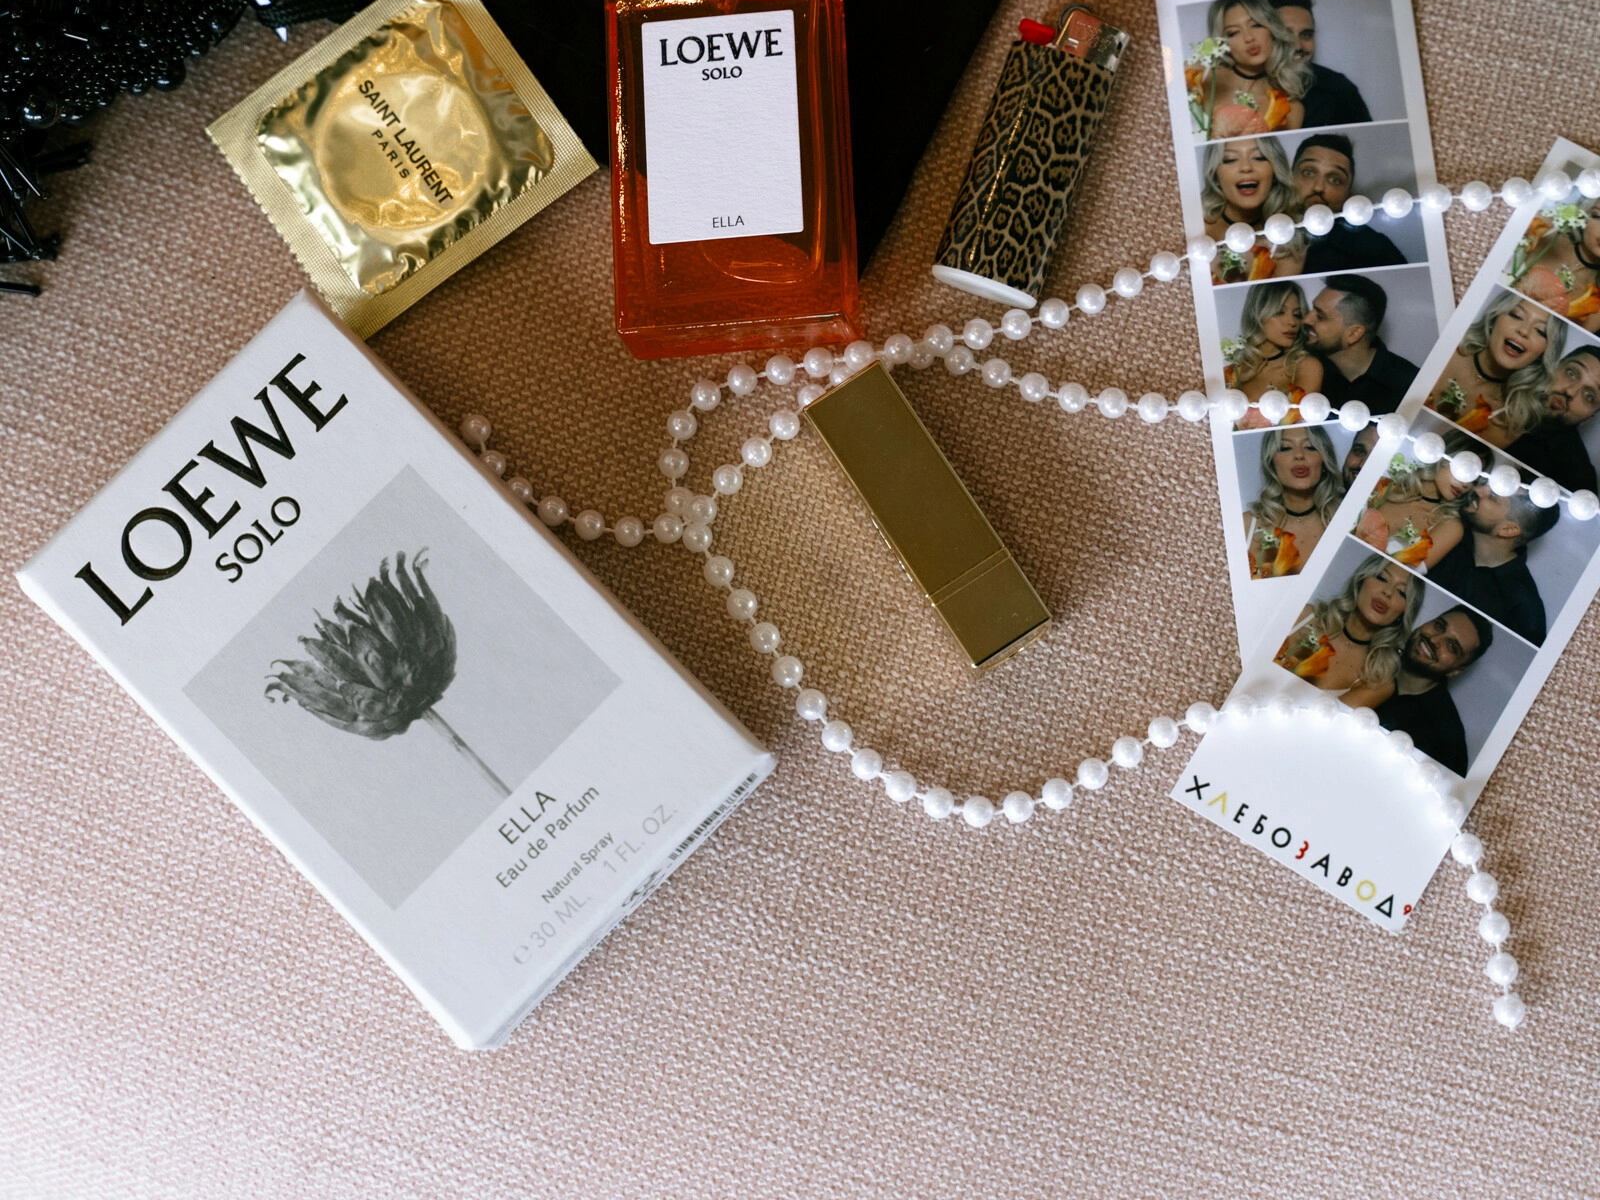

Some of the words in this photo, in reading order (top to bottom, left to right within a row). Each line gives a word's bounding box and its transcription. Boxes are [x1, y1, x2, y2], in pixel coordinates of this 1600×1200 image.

[658, 28, 783, 67] LOEWE
[701, 65, 743, 81] SOLO
[358, 79, 401, 133] SAINT
[394, 126, 454, 204] LAURENT
[371, 129, 410, 180] PARIS
[712, 215, 745, 229] ELLA
[74, 352, 349, 627] LOEWE
[215, 496, 301, 583] SOLO
[495, 858, 528, 888] Eau
[526, 838, 548, 860] de
[544, 786, 600, 839] Parfum
[498, 790, 556, 844] ELLA
[1185, 775, 1395, 918] ХЛЕБОЗАВОД
[530, 921, 556, 948] 30
[554, 894, 591, 924] ML.
[602, 859, 617, 873] 1
[615, 840, 645, 863] FL.
[642, 803, 678, 835] OZ.
[541, 861, 583, 904] Natural
[580, 831, 614, 865] Spray
